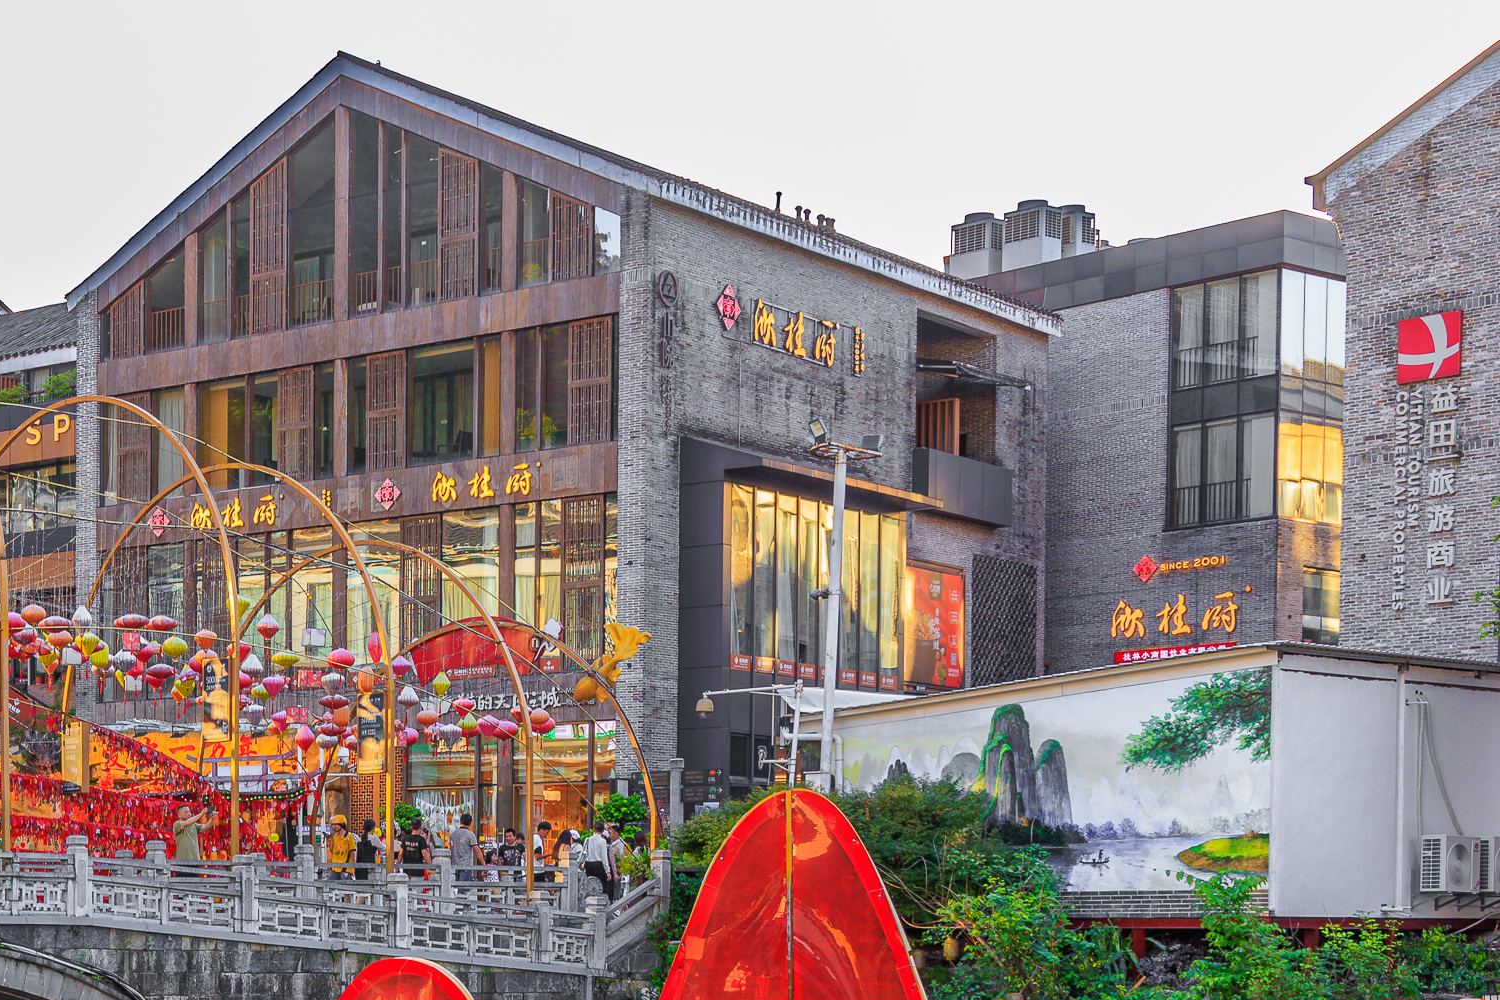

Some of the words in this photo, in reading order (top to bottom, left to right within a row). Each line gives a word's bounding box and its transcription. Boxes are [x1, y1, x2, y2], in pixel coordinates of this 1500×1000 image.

[1394, 390, 1410, 505] COMMERCIAL
[1409, 387, 1424, 446] YITIAN
[1430, 383, 1460, 448] 益田
[1407, 451, 1422, 527] TOURISM
[1160, 560, 1190, 571] SINCE
[1194, 554, 1226, 568] 2001
[1391, 510, 1407, 611] PROPERTIES
[1426, 467, 1457, 604] 旅游商业
[457, 687, 561, 713] 的天之城
